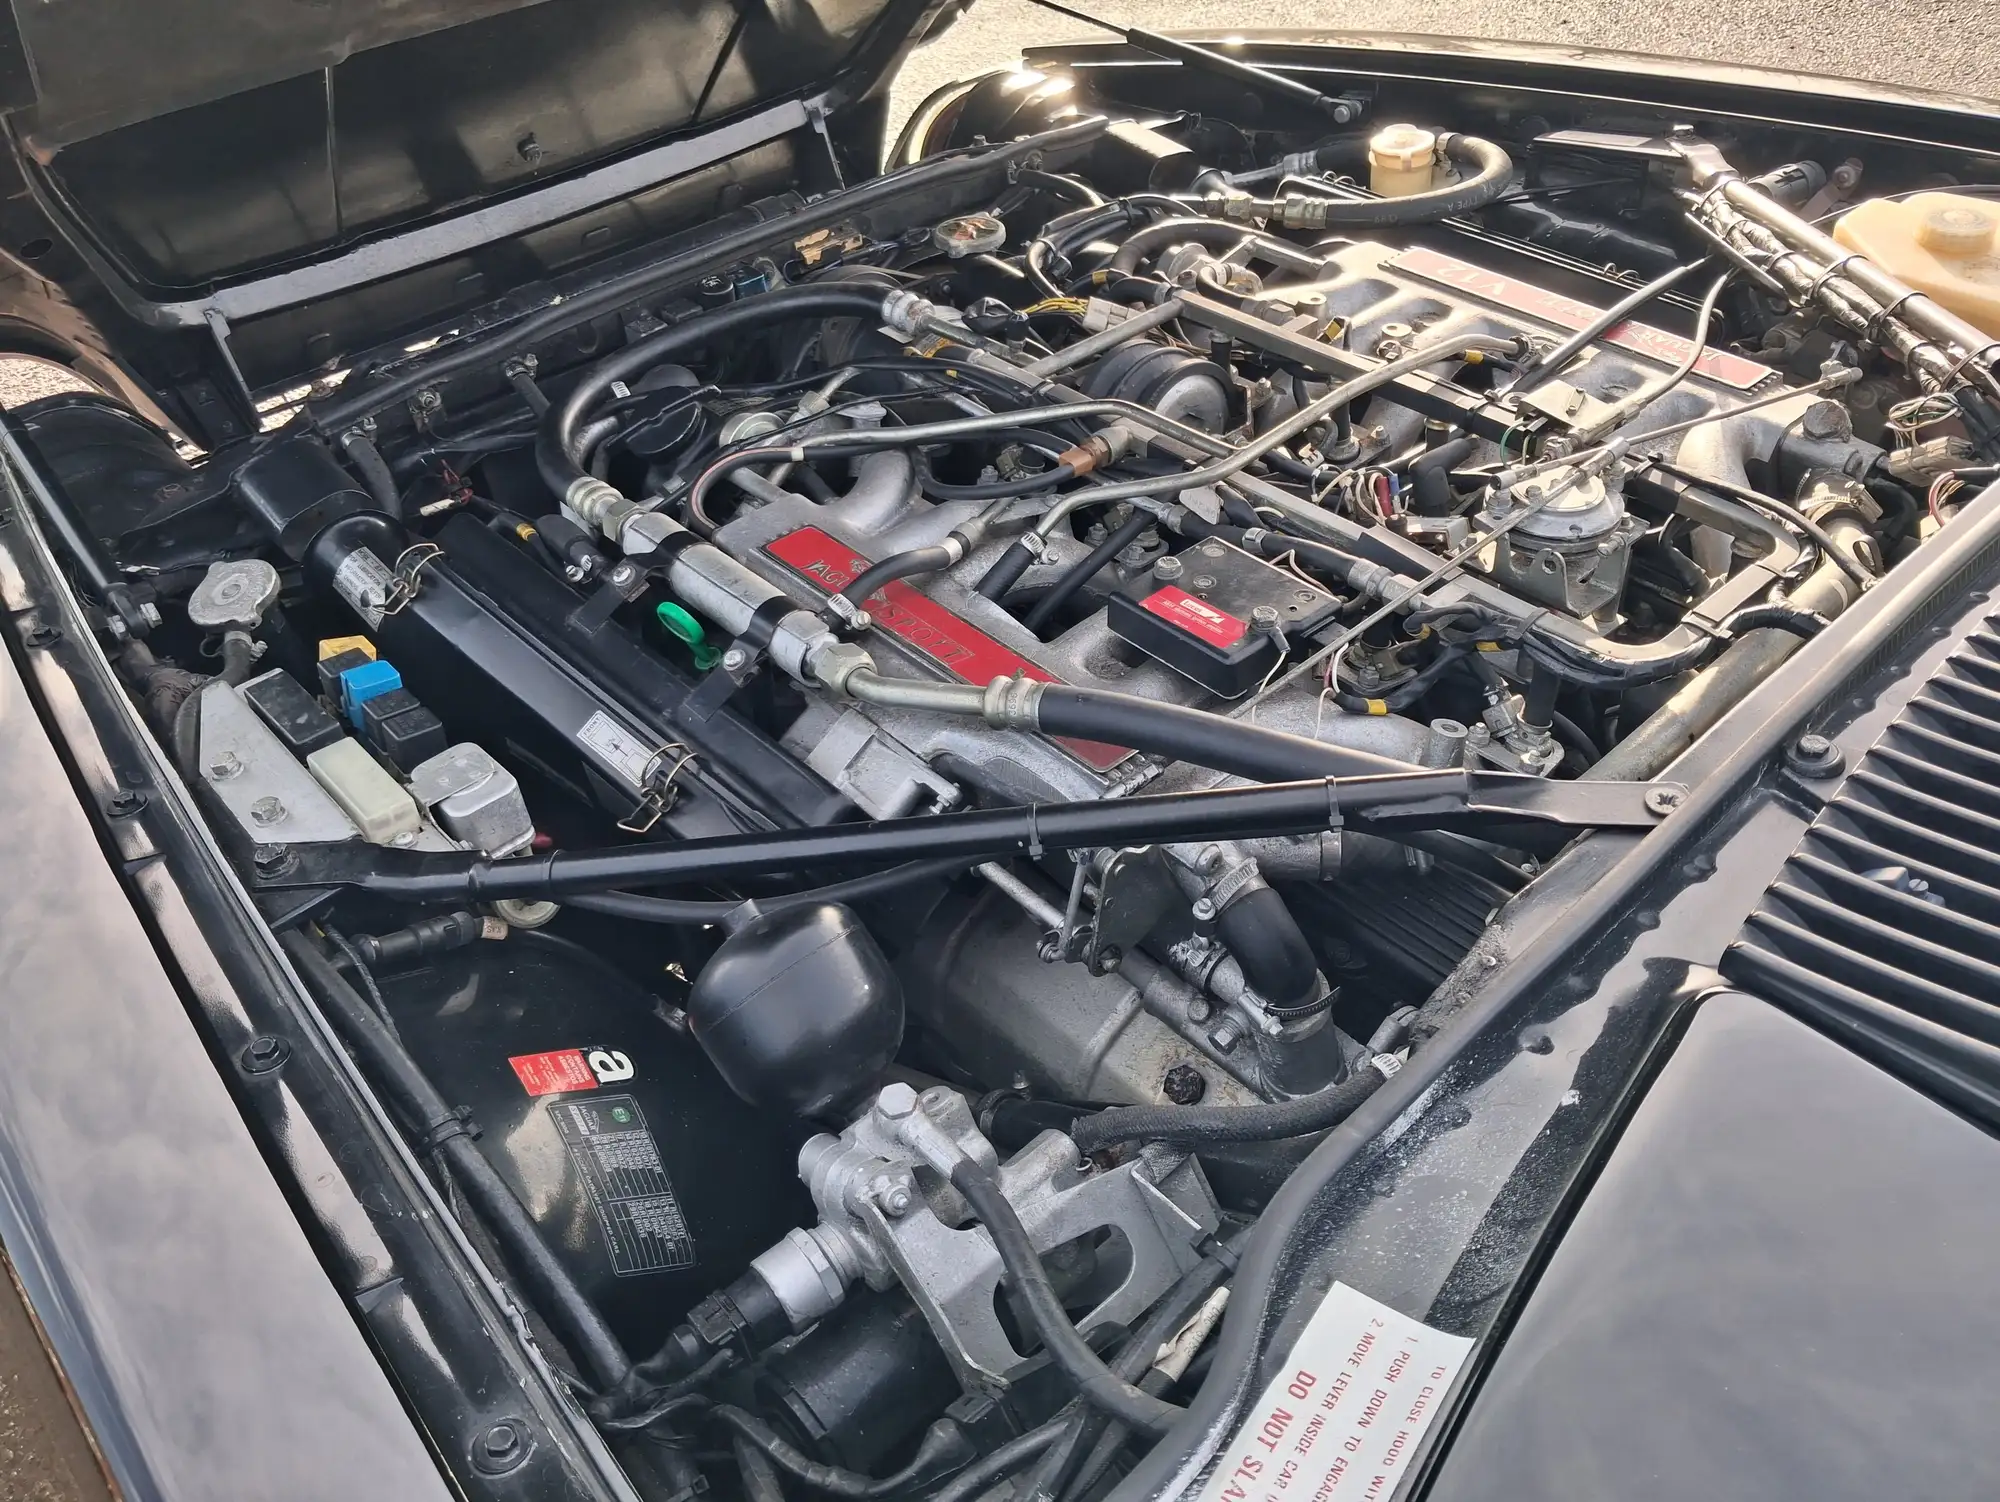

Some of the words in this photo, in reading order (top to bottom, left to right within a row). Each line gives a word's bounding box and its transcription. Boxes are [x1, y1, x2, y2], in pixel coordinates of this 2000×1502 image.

[1448, 203, 1455, 212] A
[1457, 197, 1478, 211] TYPE
[583, 717, 601, 736] FRONT
[578, 1105, 596, 1131] JAGUAR
[1367, 1317, 1385, 1329] 2.
[1347, 1332, 1377, 1369] MOVE
[1383, 1350, 1411, 1383] PUSH
[1287, 1370, 1318, 1401] DO
[1431, 1365, 1447, 1380] TO
[1321, 1371, 1353, 1411] LEVER
[1405, 1386, 1434, 1424] CLOSE
[1357, 1388, 1389, 1429] DOWN
[1256, 1407, 1294, 1454] NOT
[1343, 1436, 1362, 1452] TO
[1382, 1430, 1410, 1467] HOOD
[1220, 1453, 1264, 1502] SLA
[1273, 1459, 1299, 1491] CAR
